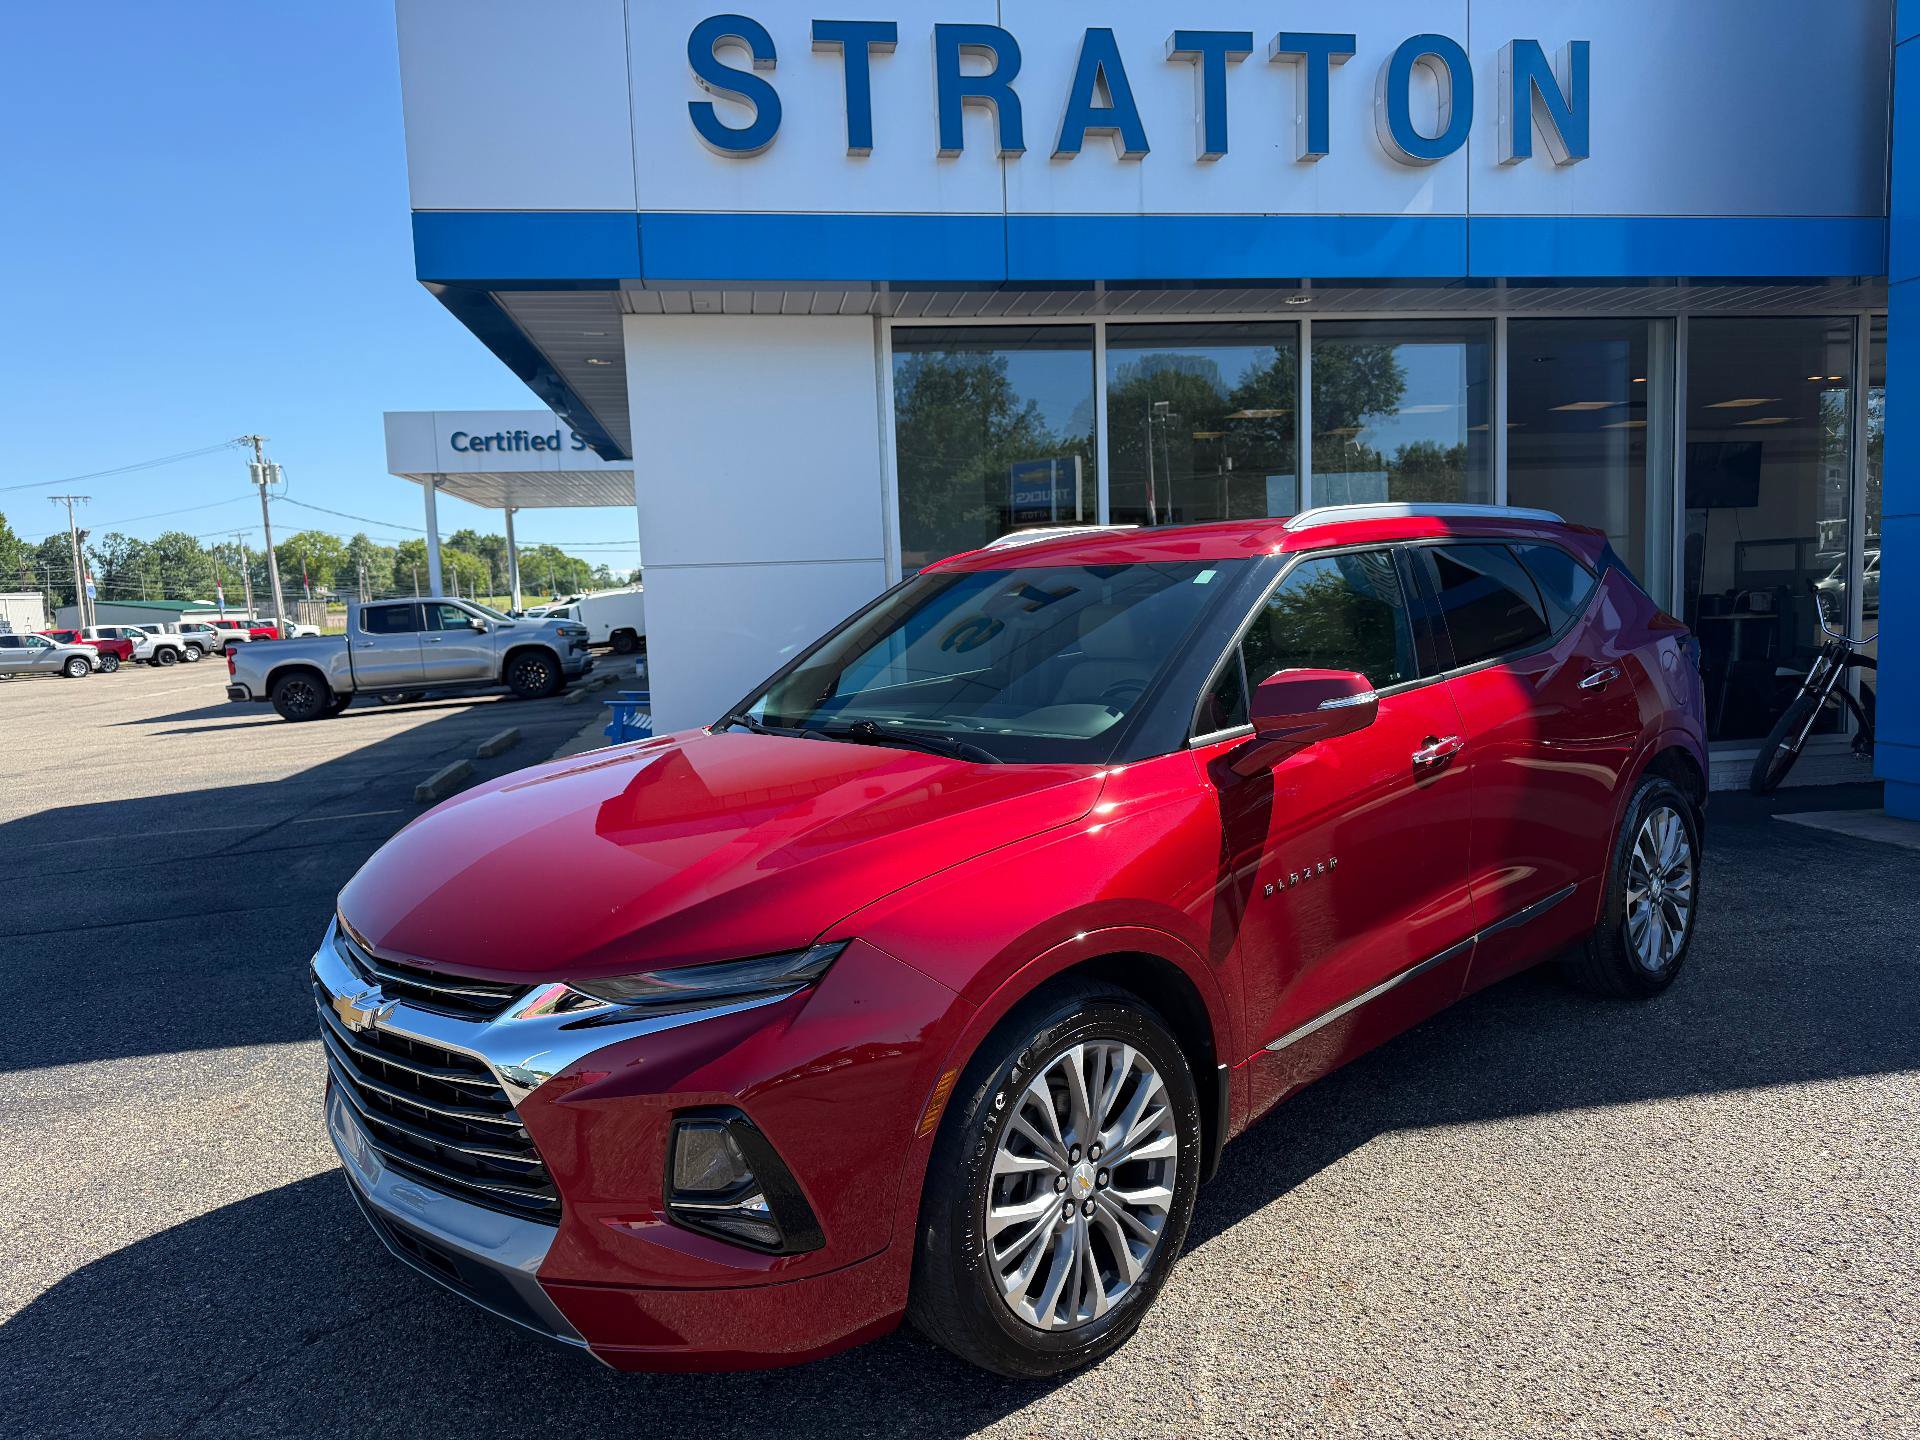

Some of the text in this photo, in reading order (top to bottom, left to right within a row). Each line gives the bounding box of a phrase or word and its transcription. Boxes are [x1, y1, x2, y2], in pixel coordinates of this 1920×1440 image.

[687, 14, 1591, 166] STRATTON
[451, 430, 561, 452] Certified
[1264, 856, 1338, 896] BLAZER
